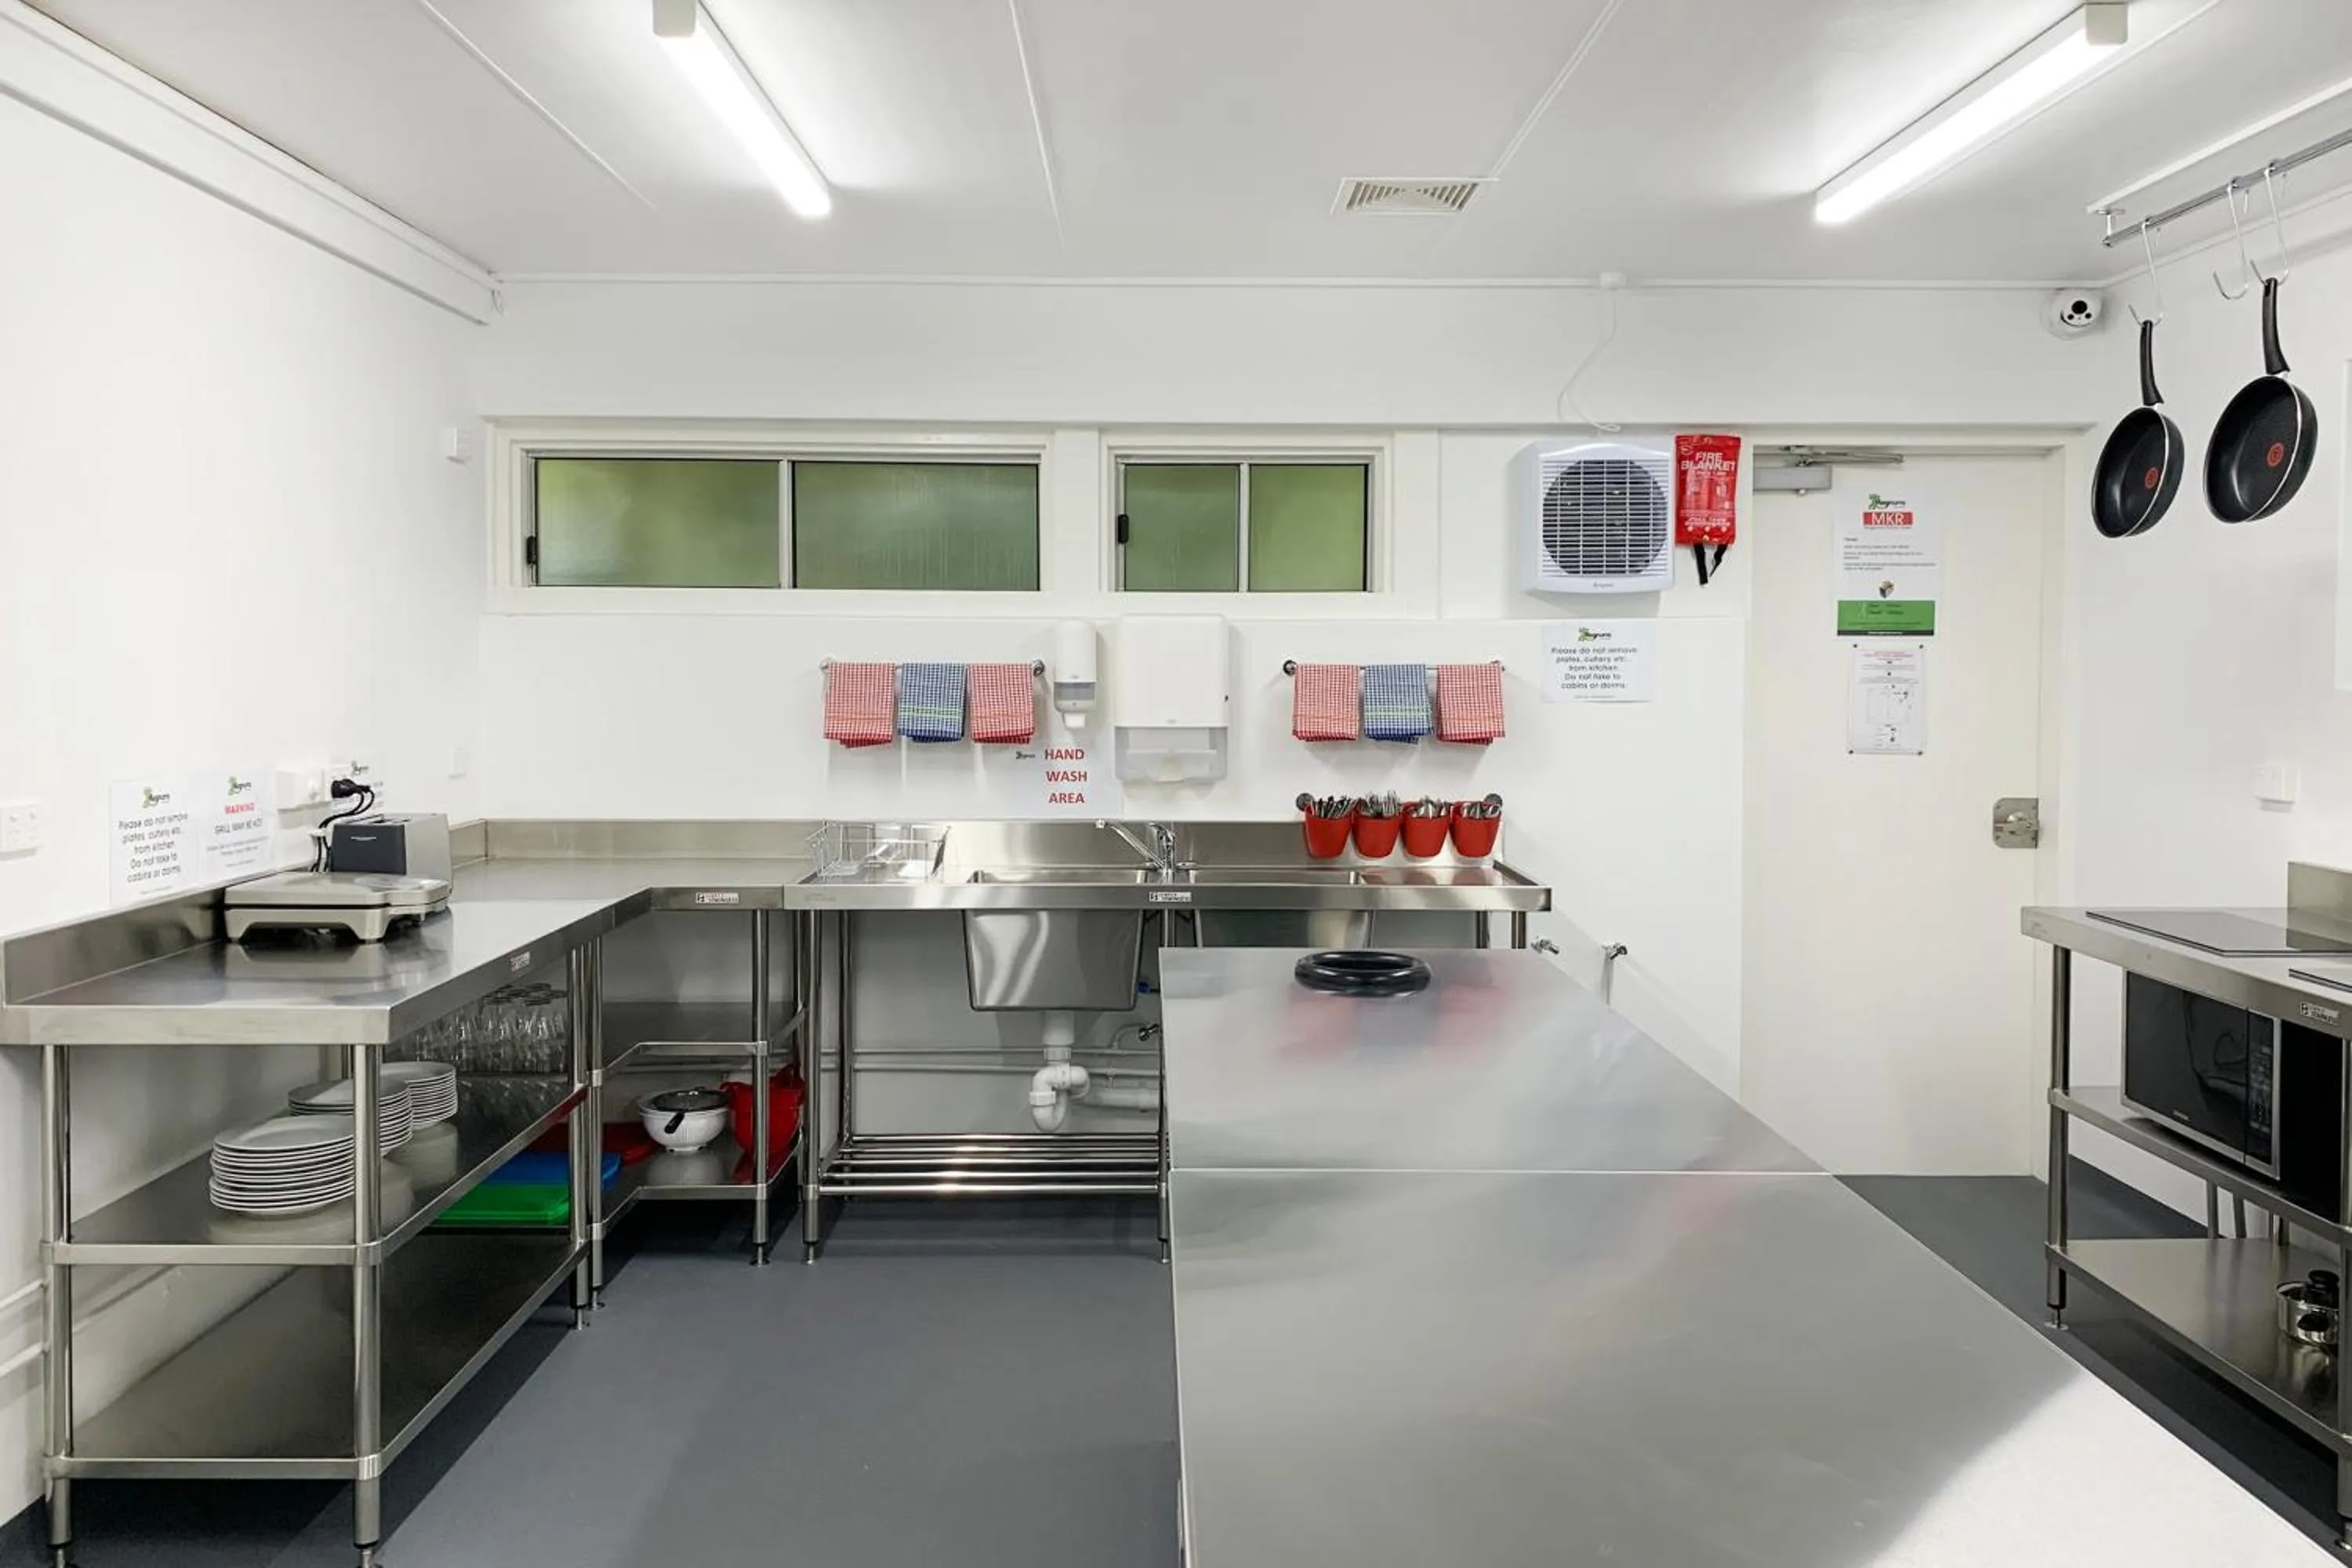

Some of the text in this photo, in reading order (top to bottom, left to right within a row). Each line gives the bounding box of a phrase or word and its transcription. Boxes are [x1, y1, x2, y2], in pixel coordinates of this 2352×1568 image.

[1695, 452, 1724, 462] FIRE
[1680, 460, 1736, 470] BLANKET
[1872, 513, 1904, 525] MKR
[1044, 749, 1084, 760] HAND
[1046, 771, 1087, 782] WASH
[1049, 793, 1085, 804] AREA
